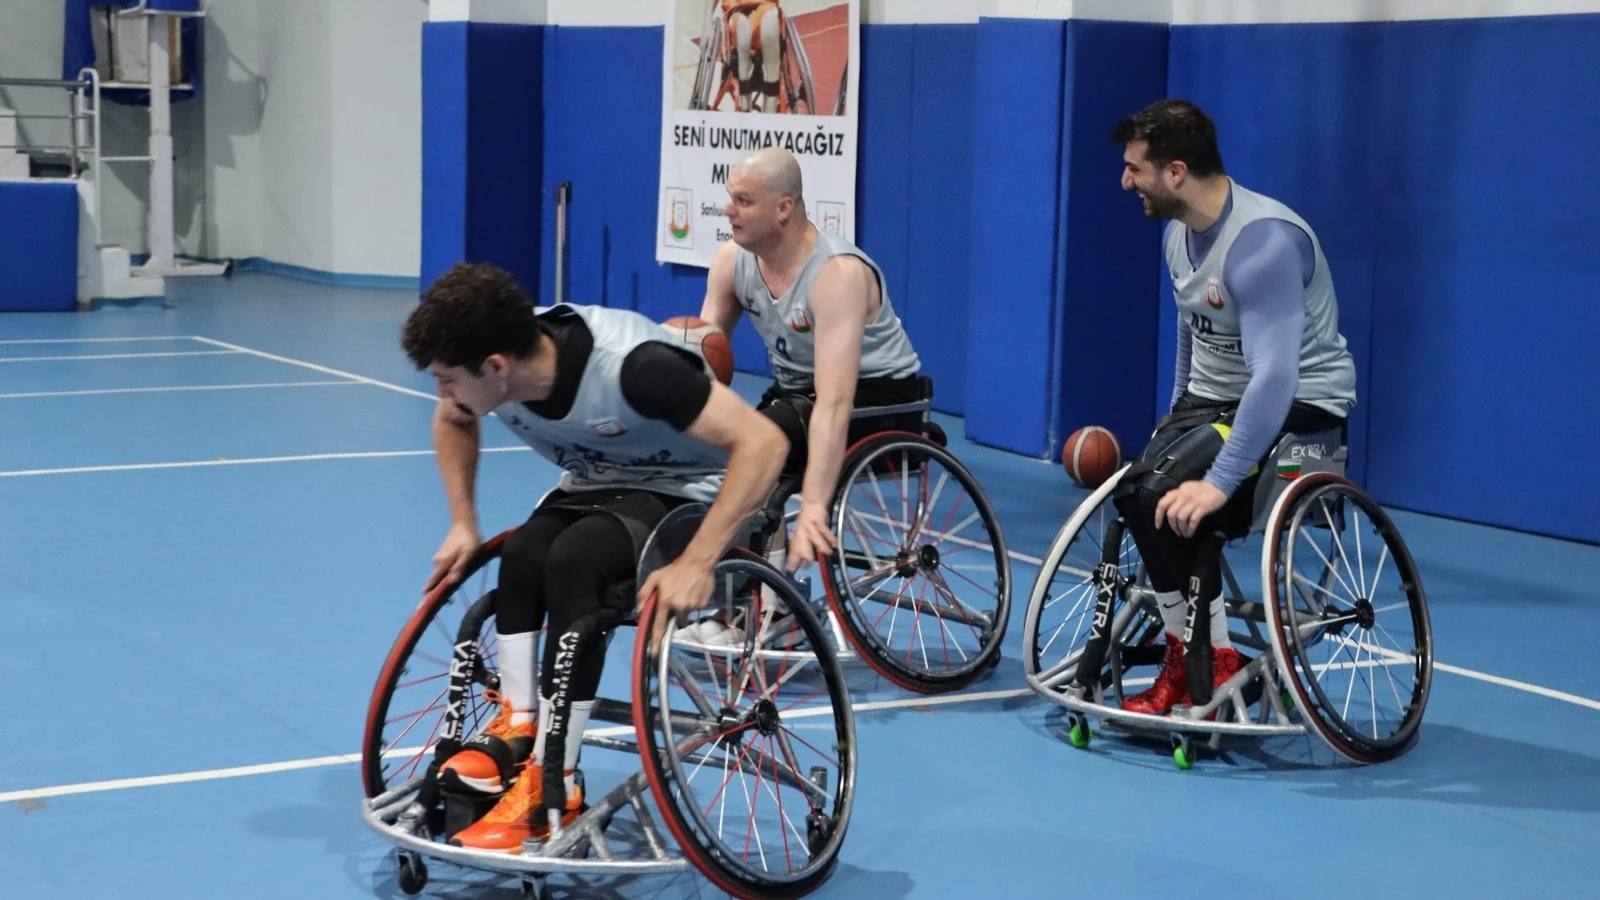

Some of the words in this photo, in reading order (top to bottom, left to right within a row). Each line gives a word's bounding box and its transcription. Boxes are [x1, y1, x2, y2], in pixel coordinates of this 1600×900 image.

[674, 119, 705, 147] SENİ
[710, 125, 844, 156] UNUTMAYACAĞIZ
[1089, 564, 1117, 640] EXTRA
[556, 631, 580, 707] WHEELCHAIR
[551, 715, 563, 735] THE
